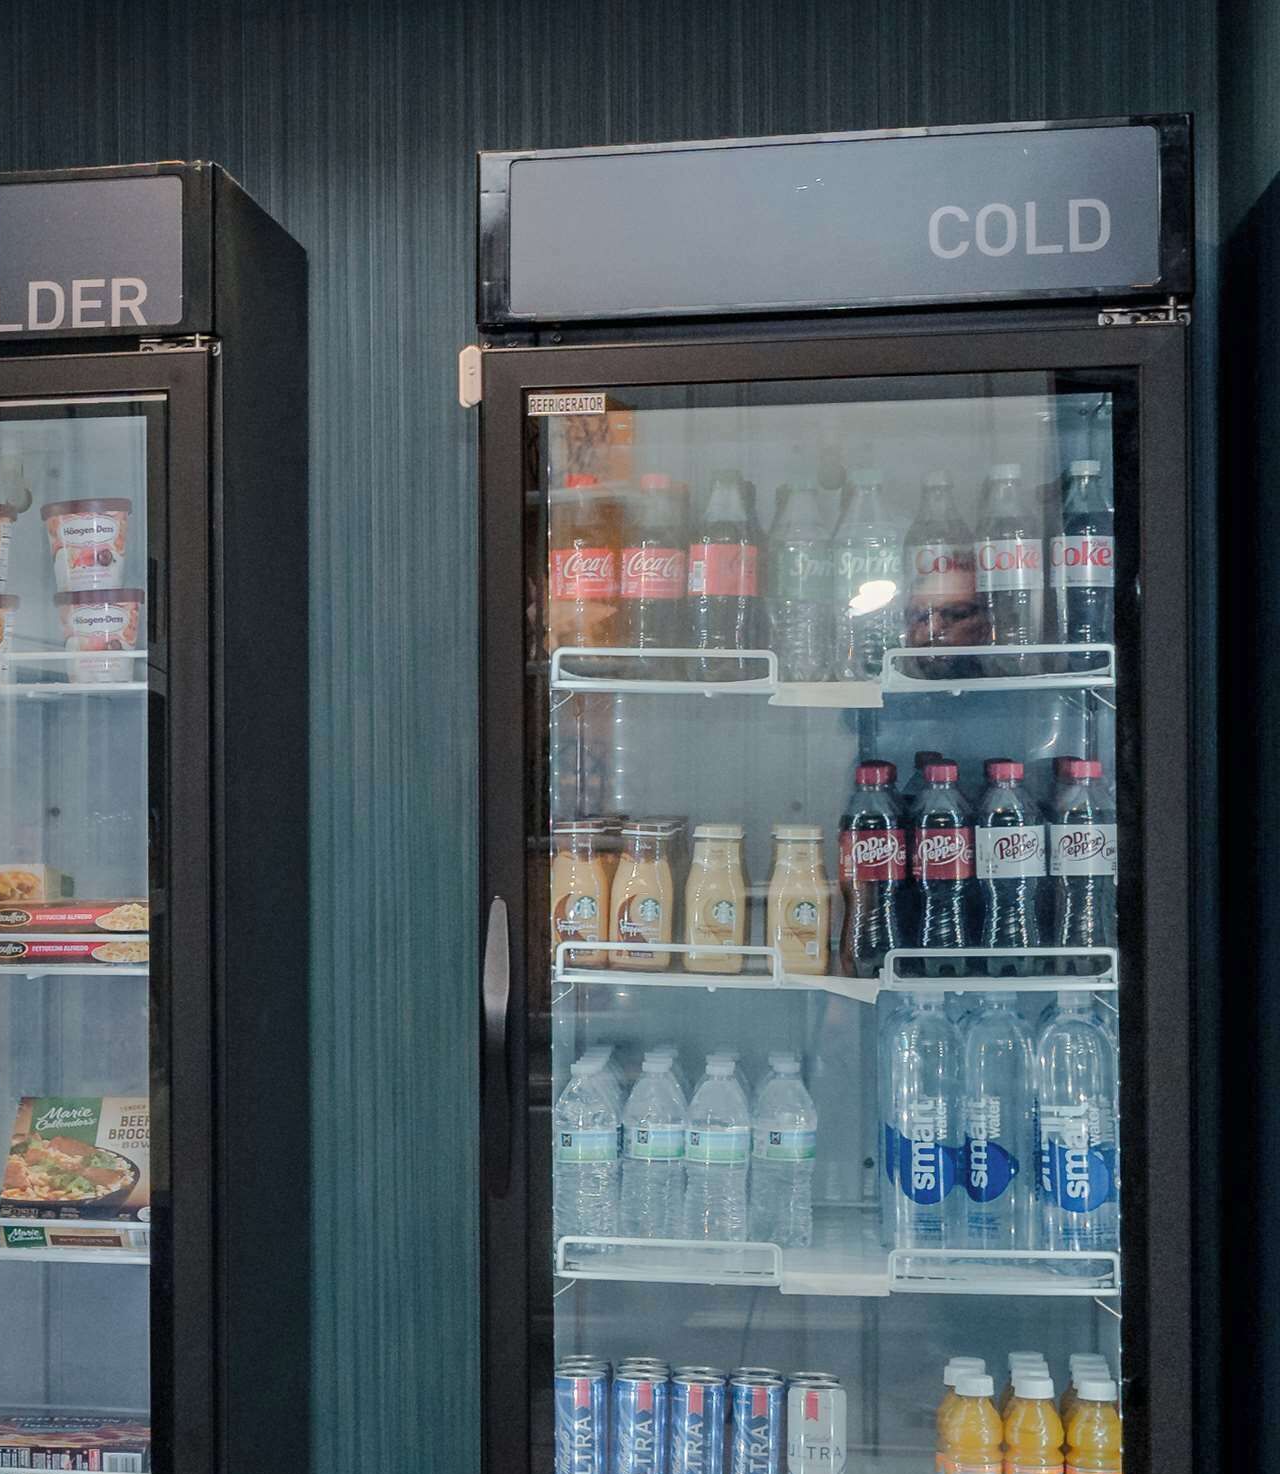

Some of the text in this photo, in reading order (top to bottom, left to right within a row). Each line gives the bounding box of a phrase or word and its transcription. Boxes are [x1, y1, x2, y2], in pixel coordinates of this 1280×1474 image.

[927, 199, 1111, 258] COLD
[529, 397, 604, 412] REFRIGERATOR
[978, 545, 1041, 571] Coke
[1050, 540, 1114, 567] Coke
[867, 837, 886, 849] Dr
[934, 836, 951, 847] Dr
[999, 838, 1037, 860] Pepper
[1010, 833, 1028, 847] Dr
[1062, 836, 1102, 858] Pepper
[1073, 832, 1091, 843] Dr
[856, 841, 895, 864] Pepper
[922, 839, 961, 862] Pepper
[37, 1107, 94, 1121] Marie
[936, 1099, 948, 1141] water
[989, 1096, 1001, 1139] water
[911, 1098, 936, 1191] smart
[965, 1098, 989, 1190] smart
[1063, 1100, 1090, 1199] smart
